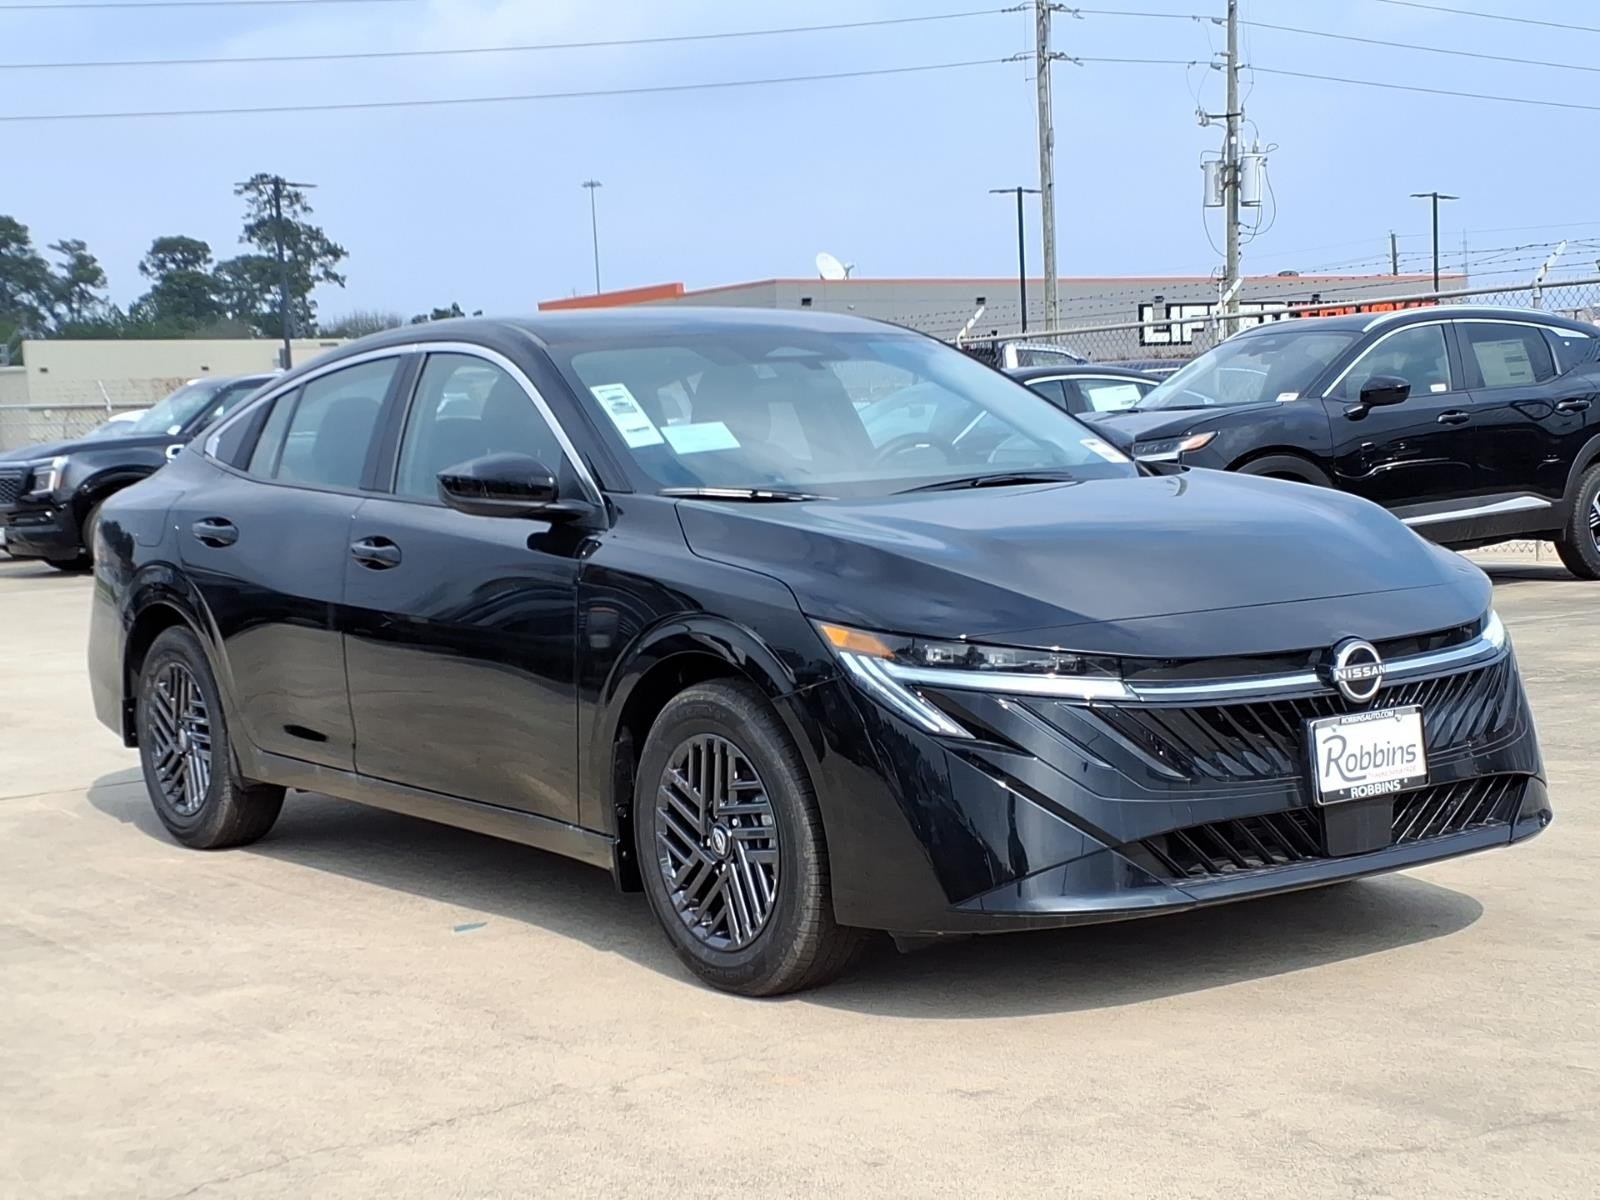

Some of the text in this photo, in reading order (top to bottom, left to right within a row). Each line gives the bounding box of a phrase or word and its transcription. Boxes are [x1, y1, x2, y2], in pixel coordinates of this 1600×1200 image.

[1334, 665, 1387, 680] NISSAN
[1322, 734, 1417, 782] Robbins
[1350, 780, 1401, 799] ROBBINS
